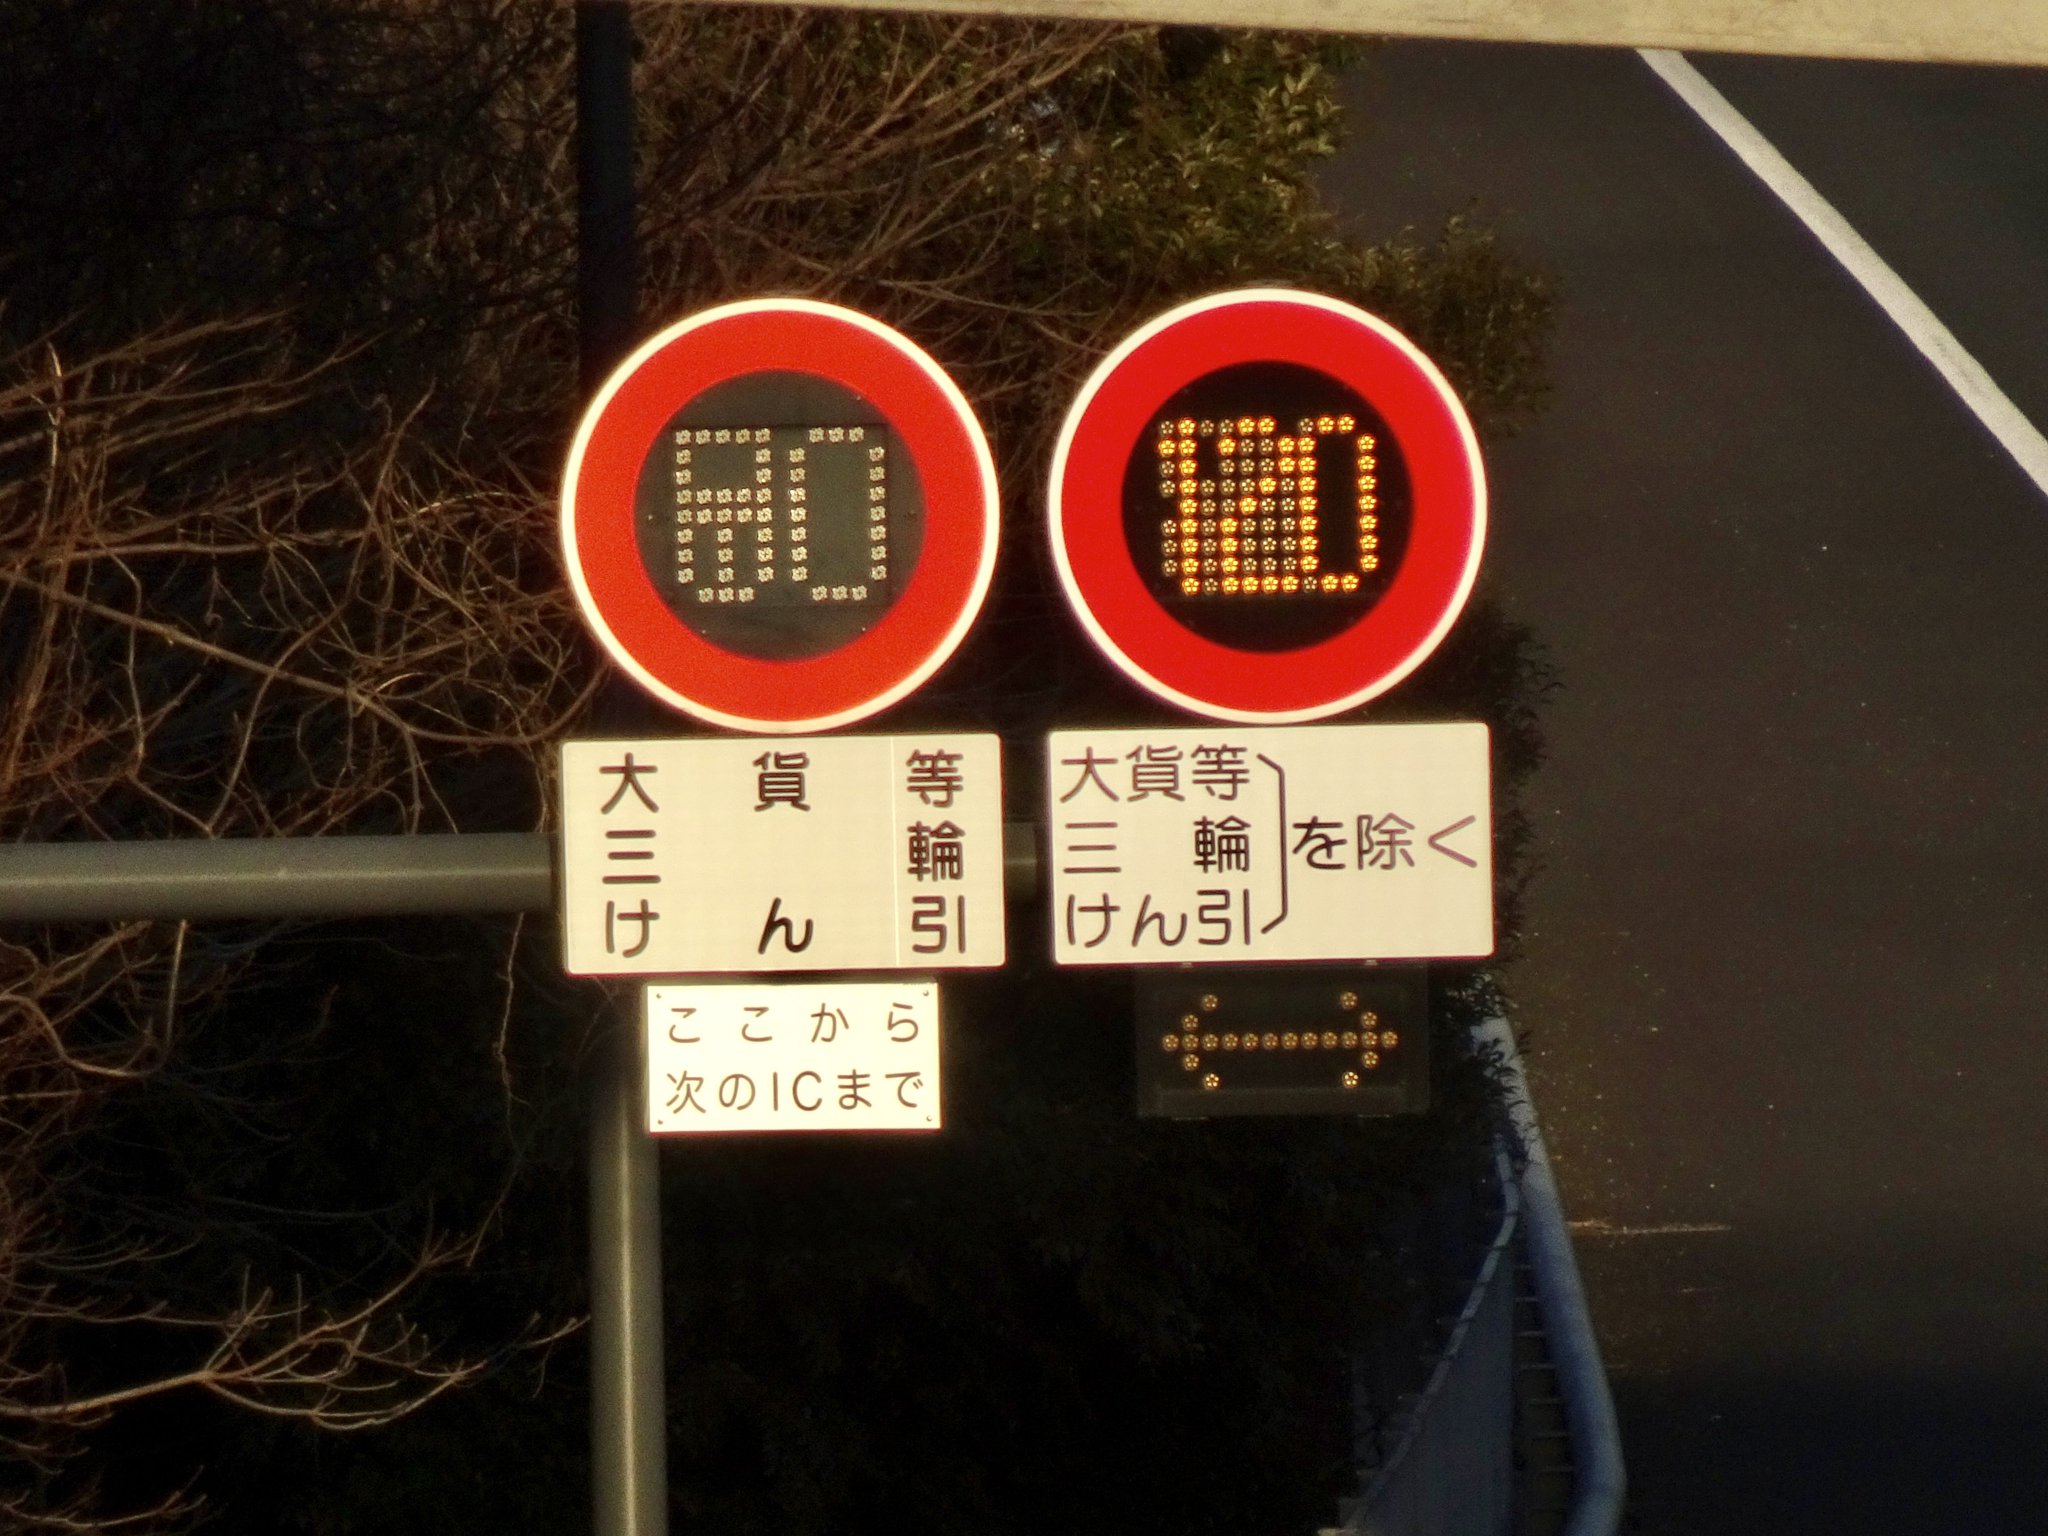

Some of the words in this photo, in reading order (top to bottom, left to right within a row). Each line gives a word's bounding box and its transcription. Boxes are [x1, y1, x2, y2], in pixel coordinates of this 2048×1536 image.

[1059, 743, 1251, 803] 大貨等
[1063, 815, 1251, 874] 三輪
[1292, 812, 1478, 871] を除く
[1065, 888, 1252, 948] けん引
[668, 1002, 920, 1044] ここから
[666, 1068, 925, 1115] 次のICまで
